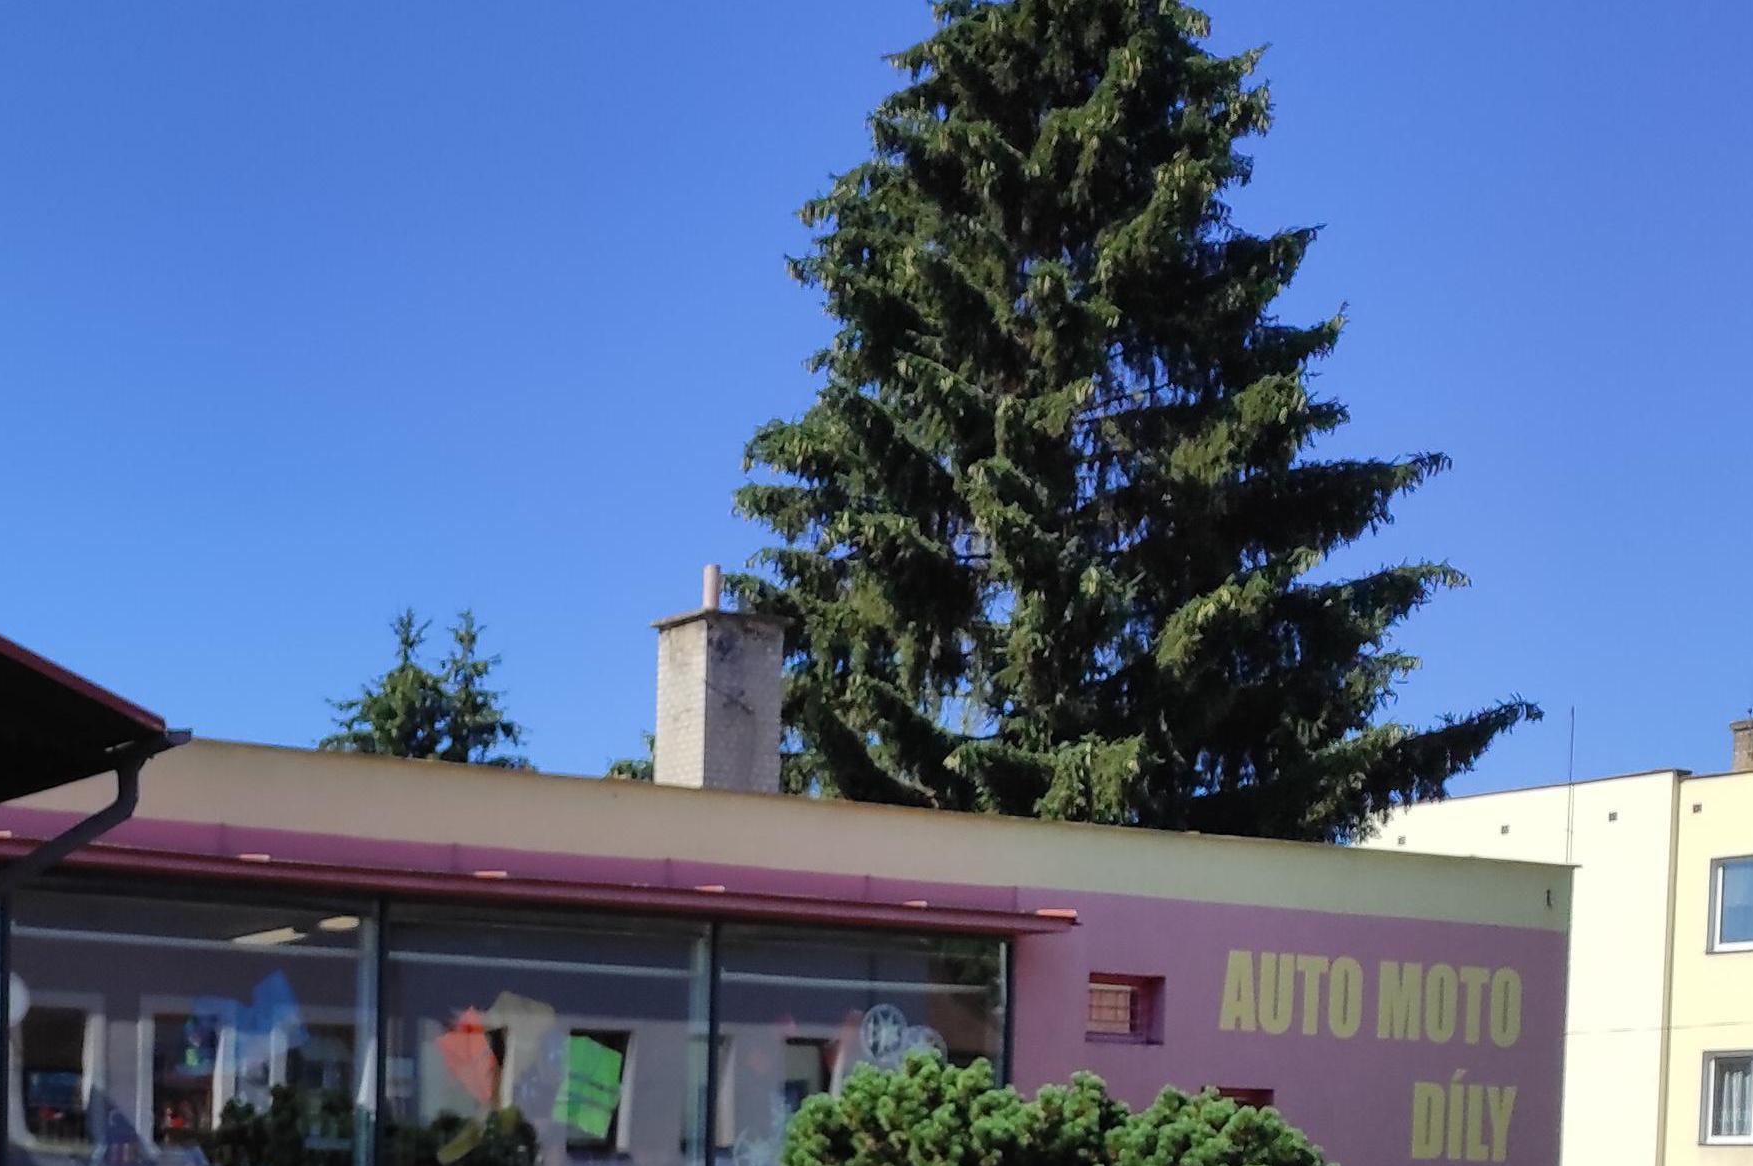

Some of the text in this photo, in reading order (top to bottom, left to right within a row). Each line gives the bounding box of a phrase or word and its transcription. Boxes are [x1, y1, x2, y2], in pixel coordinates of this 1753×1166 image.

[1218, 949, 1523, 1049] AUTO MOTO
[1411, 1068, 1518, 1163] DÍLY
